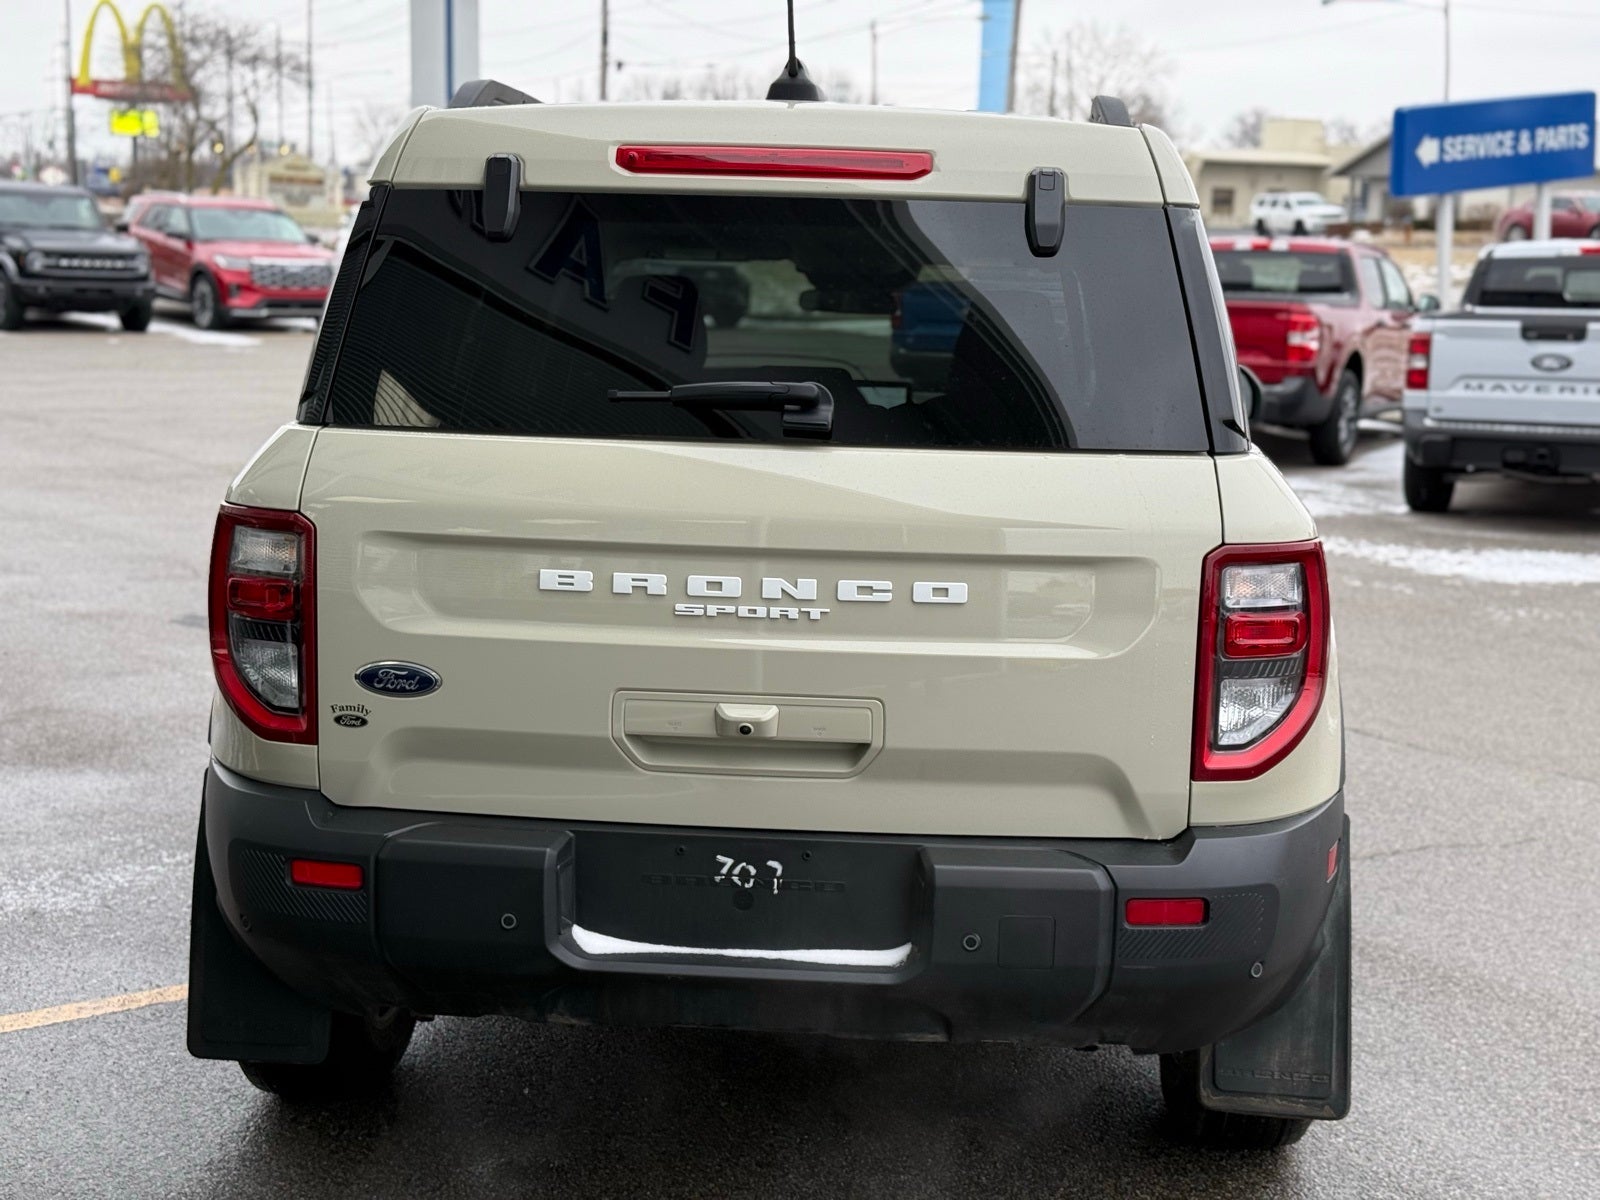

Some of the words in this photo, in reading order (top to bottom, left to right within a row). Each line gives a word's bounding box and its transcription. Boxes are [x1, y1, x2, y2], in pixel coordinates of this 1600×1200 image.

[1442, 130, 1516, 162] SERVICE
[1518, 128, 1532, 155] &
[1535, 122, 1590, 153] PARTS
[539, 568, 968, 604] BRONCO
[674, 603, 830, 620] SPORT
[373, 668, 420, 690] Ford
[330, 703, 372, 717] Family
[340, 715, 362, 727] Ford
